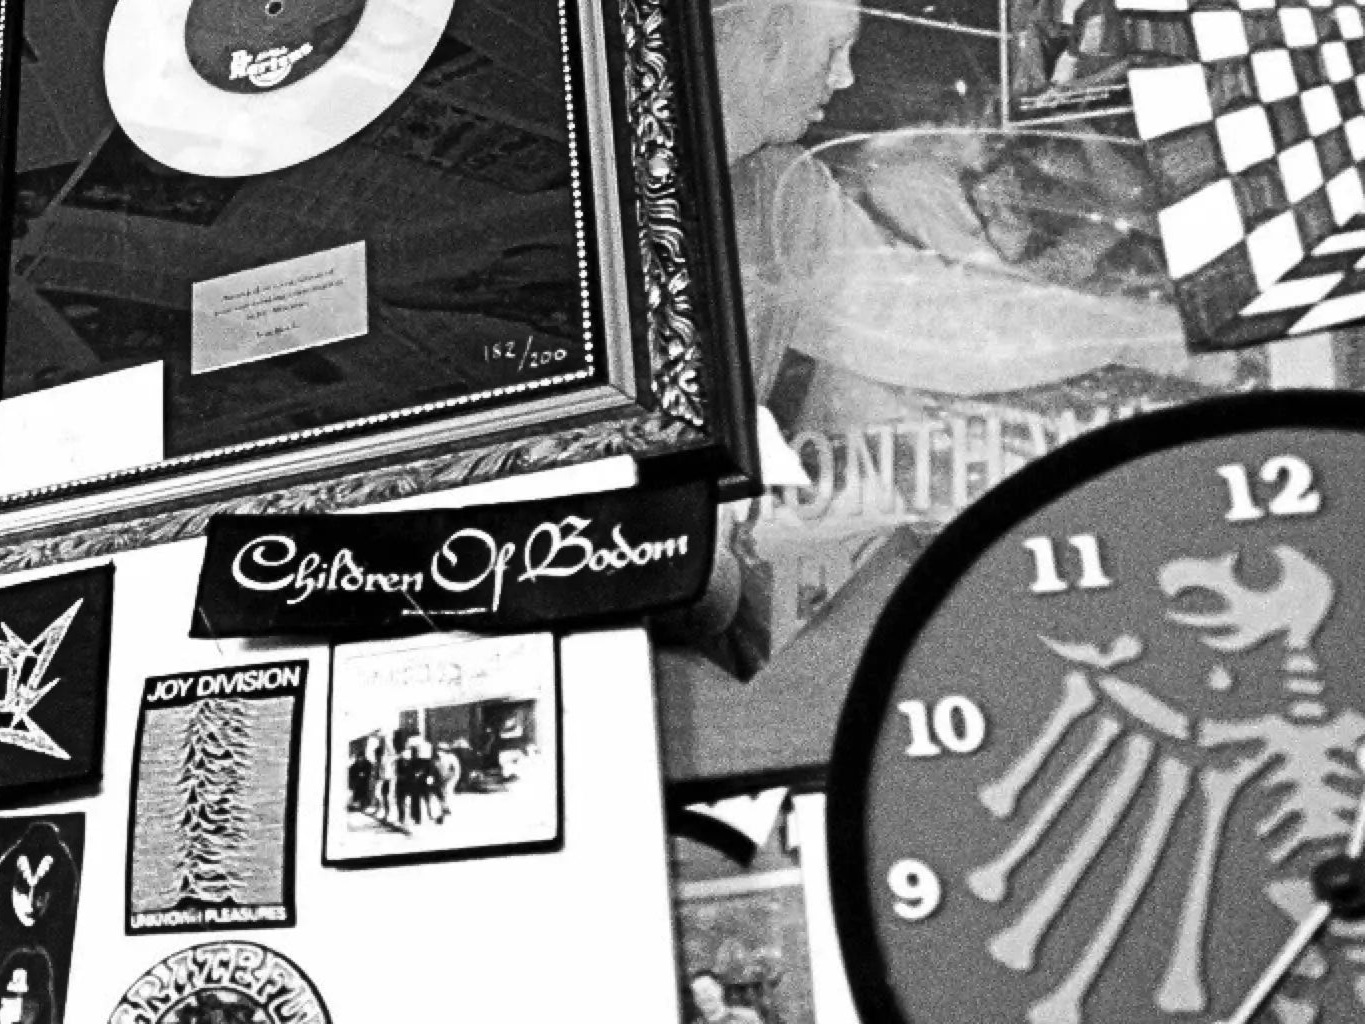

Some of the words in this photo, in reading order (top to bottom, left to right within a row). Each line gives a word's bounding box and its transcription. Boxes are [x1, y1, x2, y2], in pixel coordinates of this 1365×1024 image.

[1217, 456, 1321, 521] 12
[232, 534, 424, 605] Children
[430, 526, 517, 612] Of
[517, 513, 689, 584] Bodom
[1023, 534, 1113, 594] 11
[148, 677, 194, 703] JOY
[196, 667, 301, 700] DIVISION
[898, 696, 987, 758] 10
[203, 905, 287, 923] PLEASURES
[886, 859, 942, 920] 9
